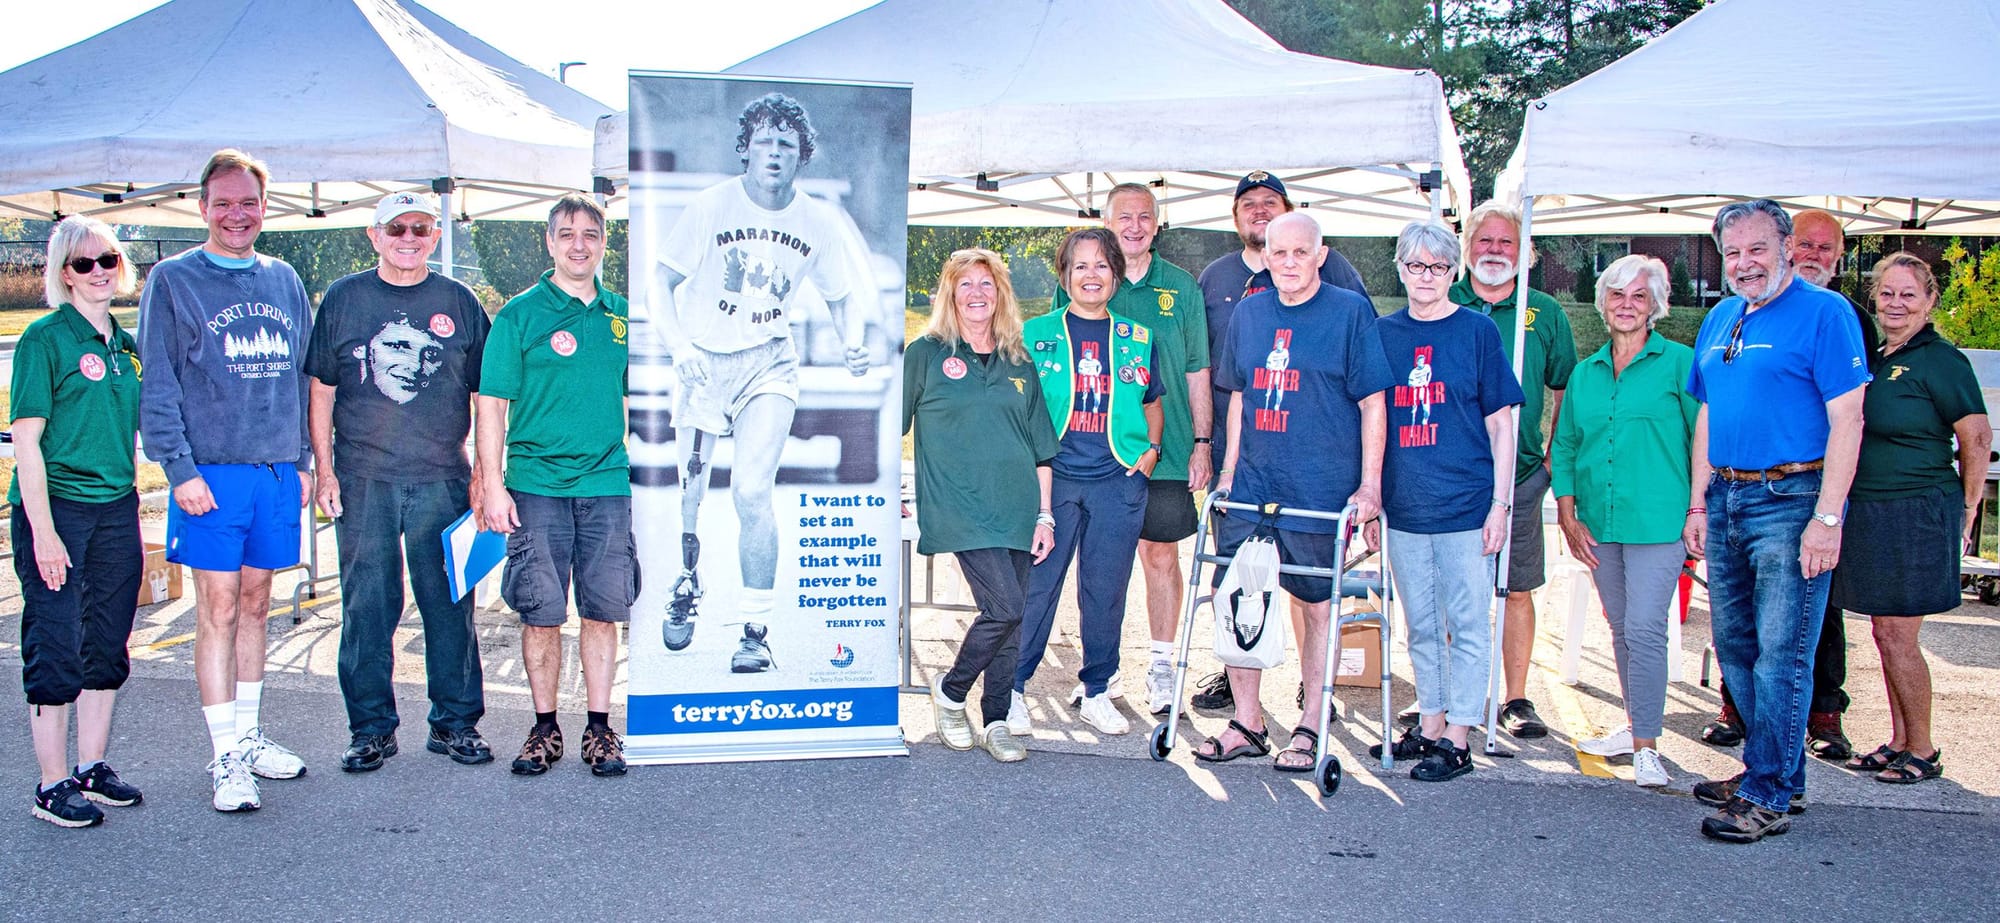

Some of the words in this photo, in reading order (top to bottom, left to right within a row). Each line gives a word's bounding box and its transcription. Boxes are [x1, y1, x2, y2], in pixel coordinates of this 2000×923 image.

[716, 228, 811, 257] MARATHON
[718, 300, 737, 316] OF
[207, 303, 243, 335] PORT
[246, 302, 293, 331] LORING
[437, 323, 449, 333] ME
[559, 340, 572, 350] ME
[1273, 328, 1292, 350] NO
[1081, 341, 1099, 359] NO
[1413, 345, 1433, 368] NO
[88, 364, 101, 376] ME
[226, 363, 245, 373] THE
[246, 362, 265, 372] PORT
[266, 361, 291, 371] SHORES
[949, 366, 962, 375] ME
[1253, 367, 1301, 391] MATTER
[1394, 381, 1446, 407] MATTER
[1070, 410, 1107, 433] WHAT
[1255, 408, 1290, 433] WHAT
[1399, 423, 1439, 448] WHAT
[799, 493, 808, 507] I
[812, 495, 861, 507] want
[866, 495, 886, 507] to
[799, 515, 827, 527] set
[831, 516, 854, 527] an
[799, 534, 877, 550] example
[798, 554, 839, 567] that
[843, 553, 882, 567] will
[798, 577, 851, 588] never
[856, 573, 877, 587] be
[798, 594, 887, 610] forgotten
[825, 619, 861, 628] TERRY
[864, 619, 886, 627] FOX
[672, 699, 853, 725] terryfox.org
